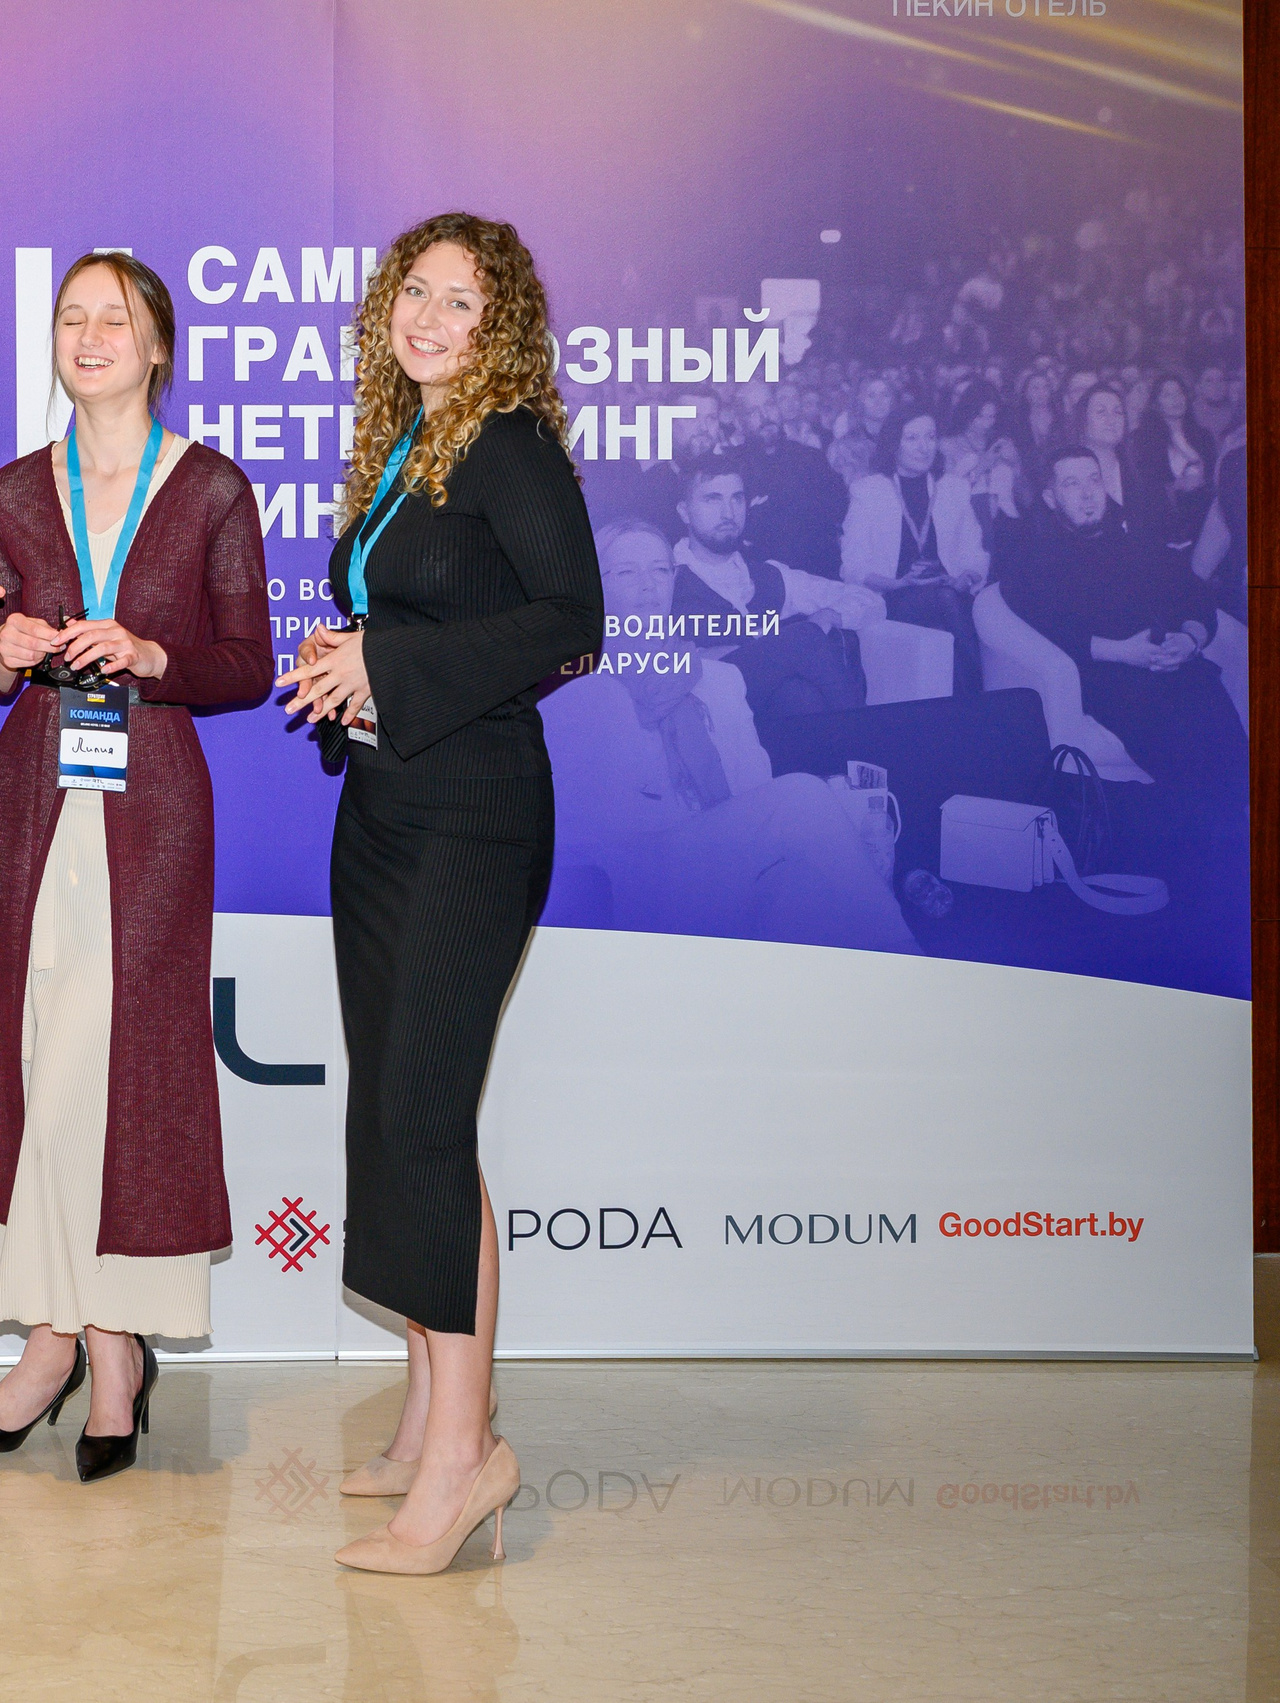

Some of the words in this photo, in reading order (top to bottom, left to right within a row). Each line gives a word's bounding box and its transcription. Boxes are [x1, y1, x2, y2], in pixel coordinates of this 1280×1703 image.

[187, 246, 380, 304] САМ
[70, 709, 121, 723] КОМАНДА
[725, 1213, 917, 1244] MODUM
[938, 1211, 1144, 1243] GoodStart.by
